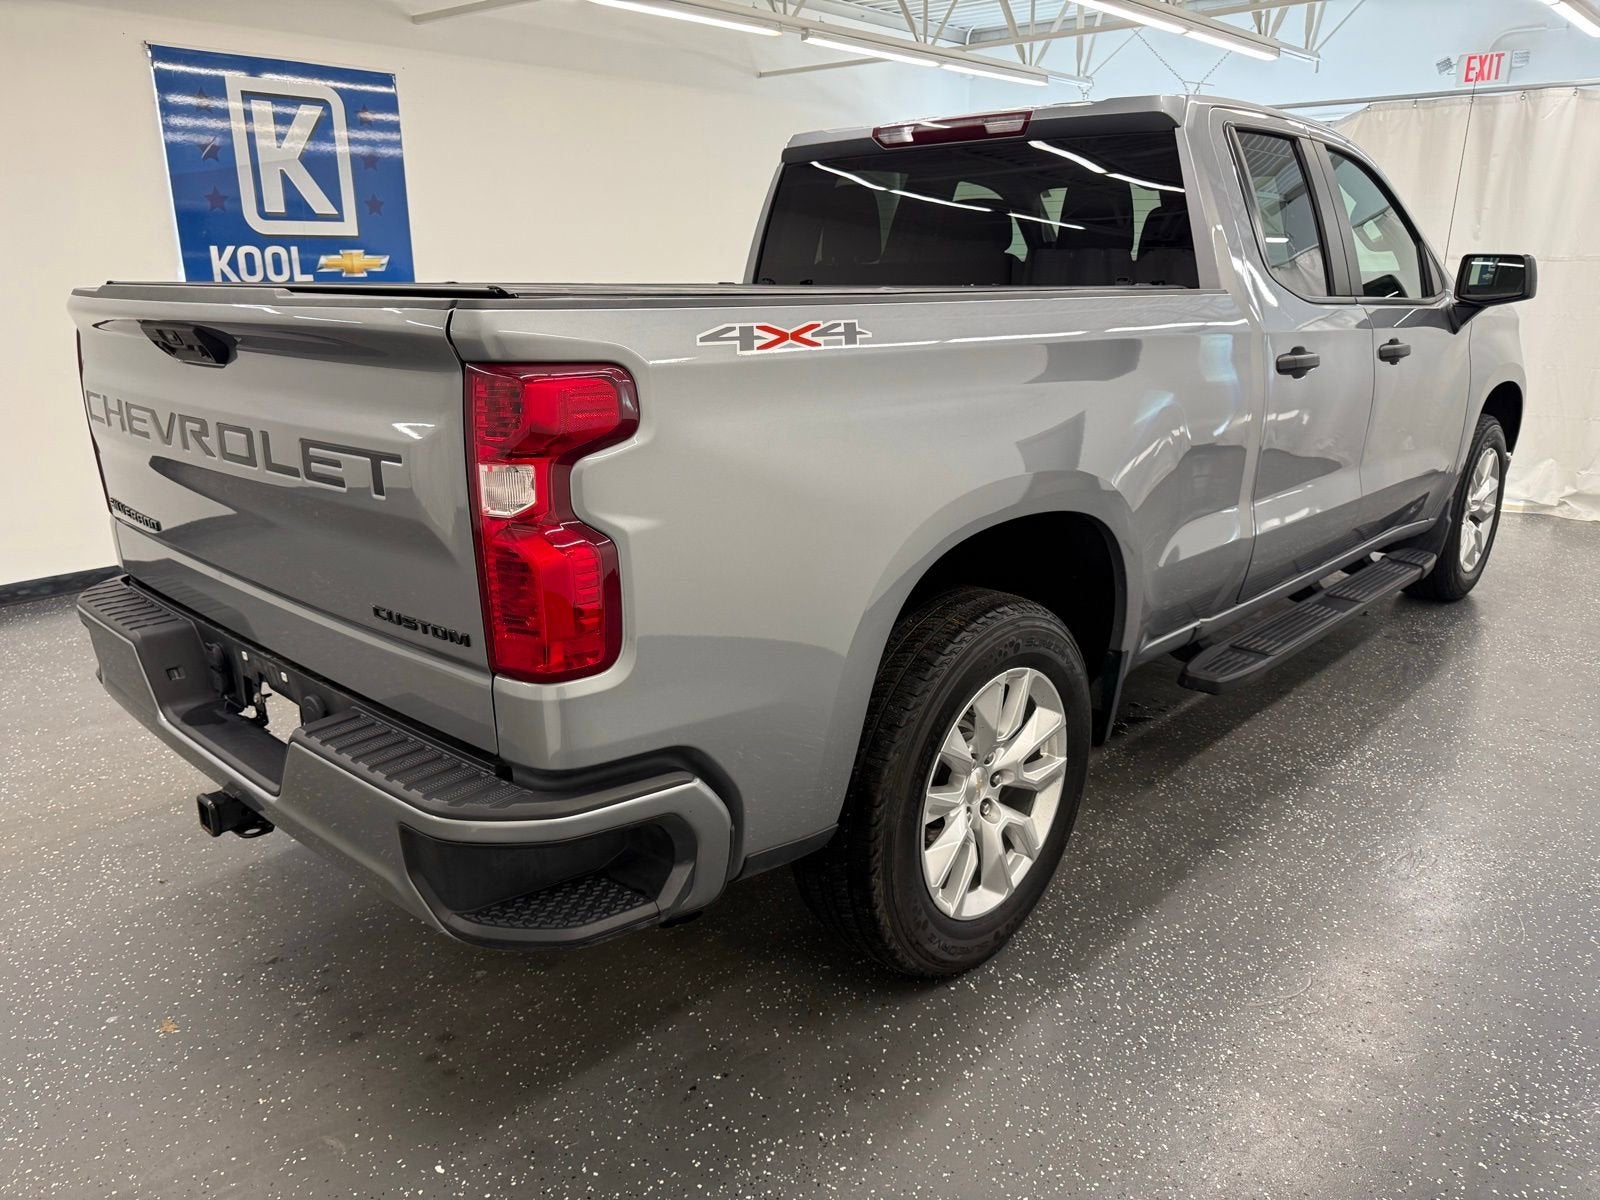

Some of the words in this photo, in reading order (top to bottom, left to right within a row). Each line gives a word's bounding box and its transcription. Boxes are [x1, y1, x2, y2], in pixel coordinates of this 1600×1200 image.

[1463, 52, 1505, 82] EXIT
[250, 99, 339, 214] K
[209, 245, 314, 282] KOOL
[86, 390, 403, 500] CHEVROLET
[371, 604, 471, 647] CUSTOM
